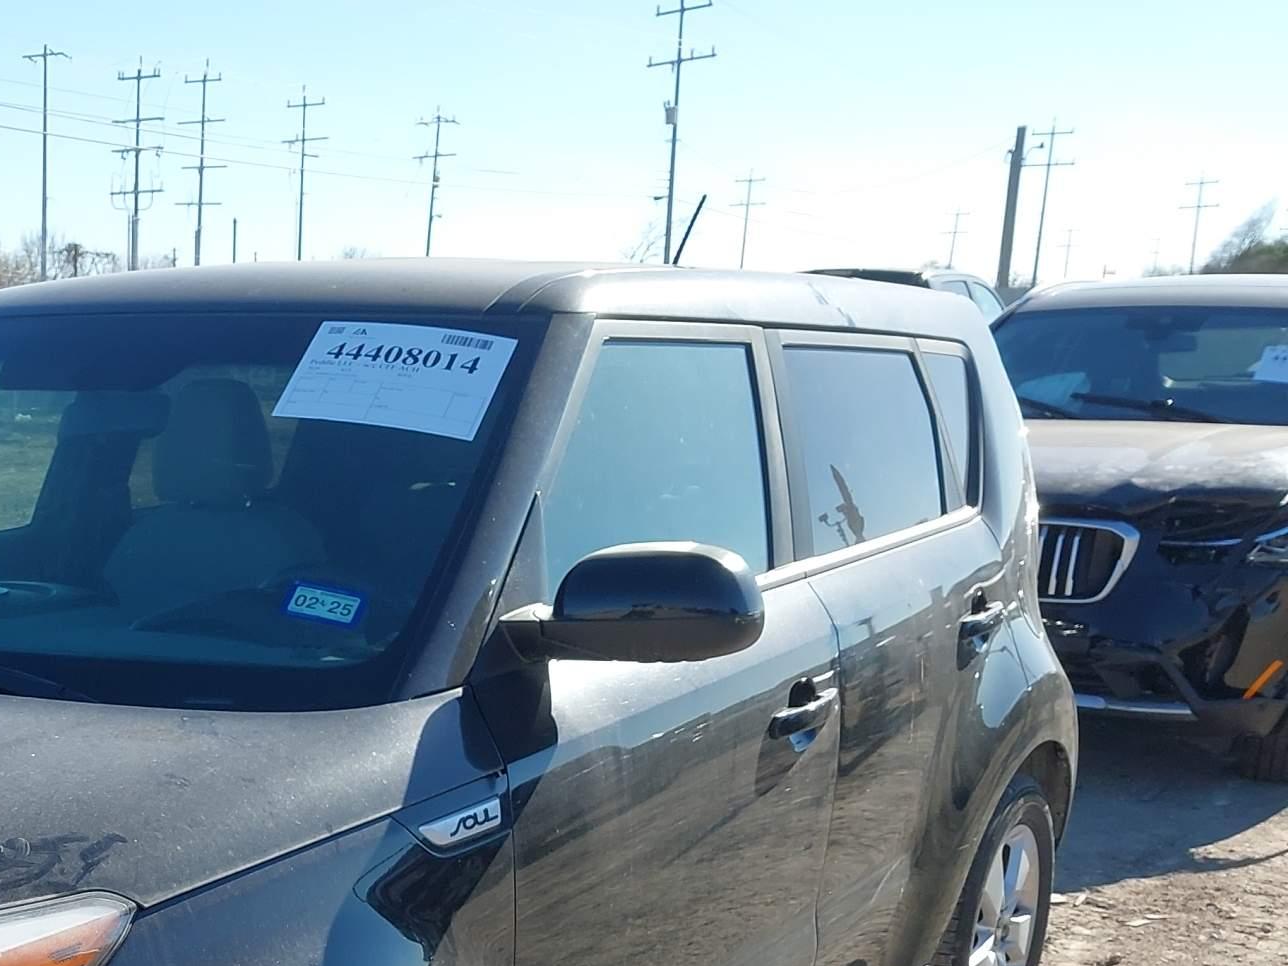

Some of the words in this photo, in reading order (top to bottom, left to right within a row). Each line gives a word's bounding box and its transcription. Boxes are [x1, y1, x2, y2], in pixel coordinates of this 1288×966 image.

[326, 341, 481, 375] 44408014
[294, 594, 319, 610] 02
[327, 600, 353, 617] 25
